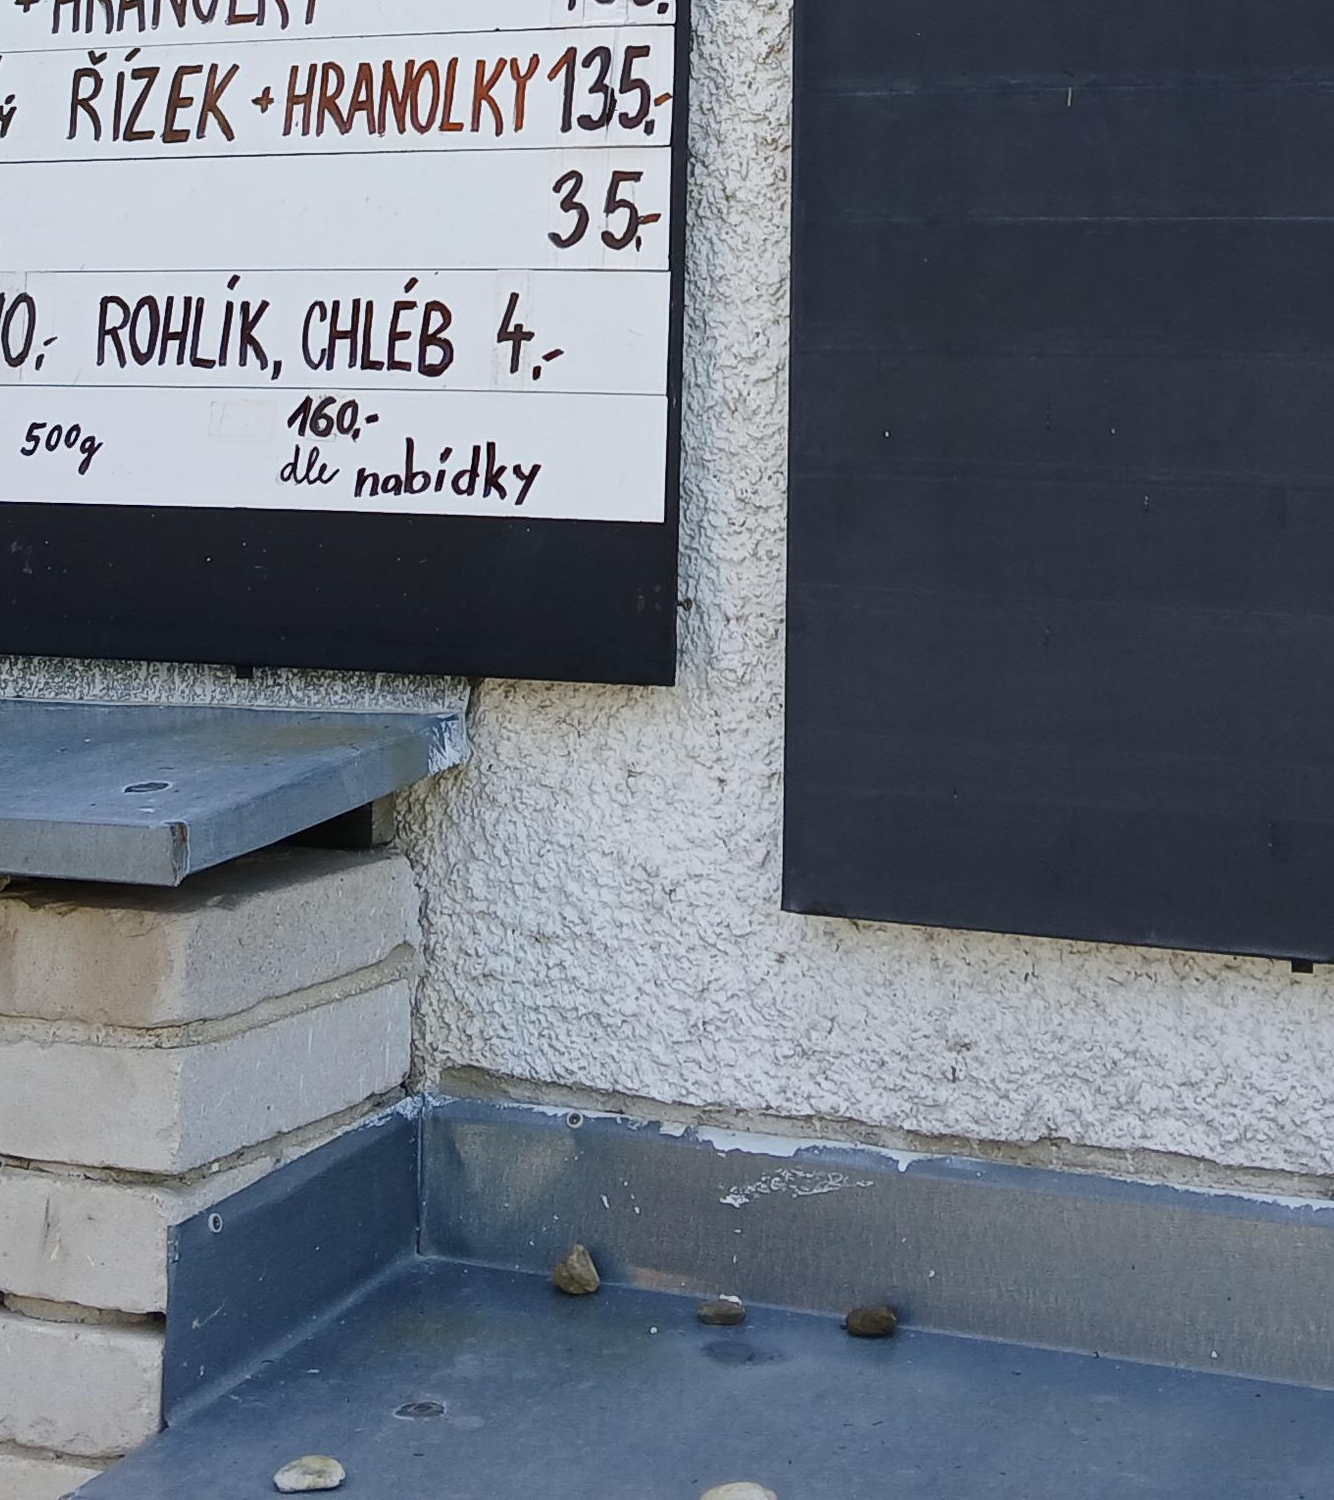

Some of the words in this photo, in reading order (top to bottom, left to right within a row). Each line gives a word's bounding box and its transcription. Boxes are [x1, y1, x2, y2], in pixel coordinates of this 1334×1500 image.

[67, 48, 239, 144] ŘÍZEK
[282, 54, 540, 137] HRANOLKY
[96, 275, 282, 380] ROHLÍK,
[302, 277, 454, 377] CHLÉB
[497, 292, 564, 380] 4,-
[287, 395, 379, 442] 160,-
[280, 444, 339, 485] dle
[351, 434, 541, 505] nabídky
